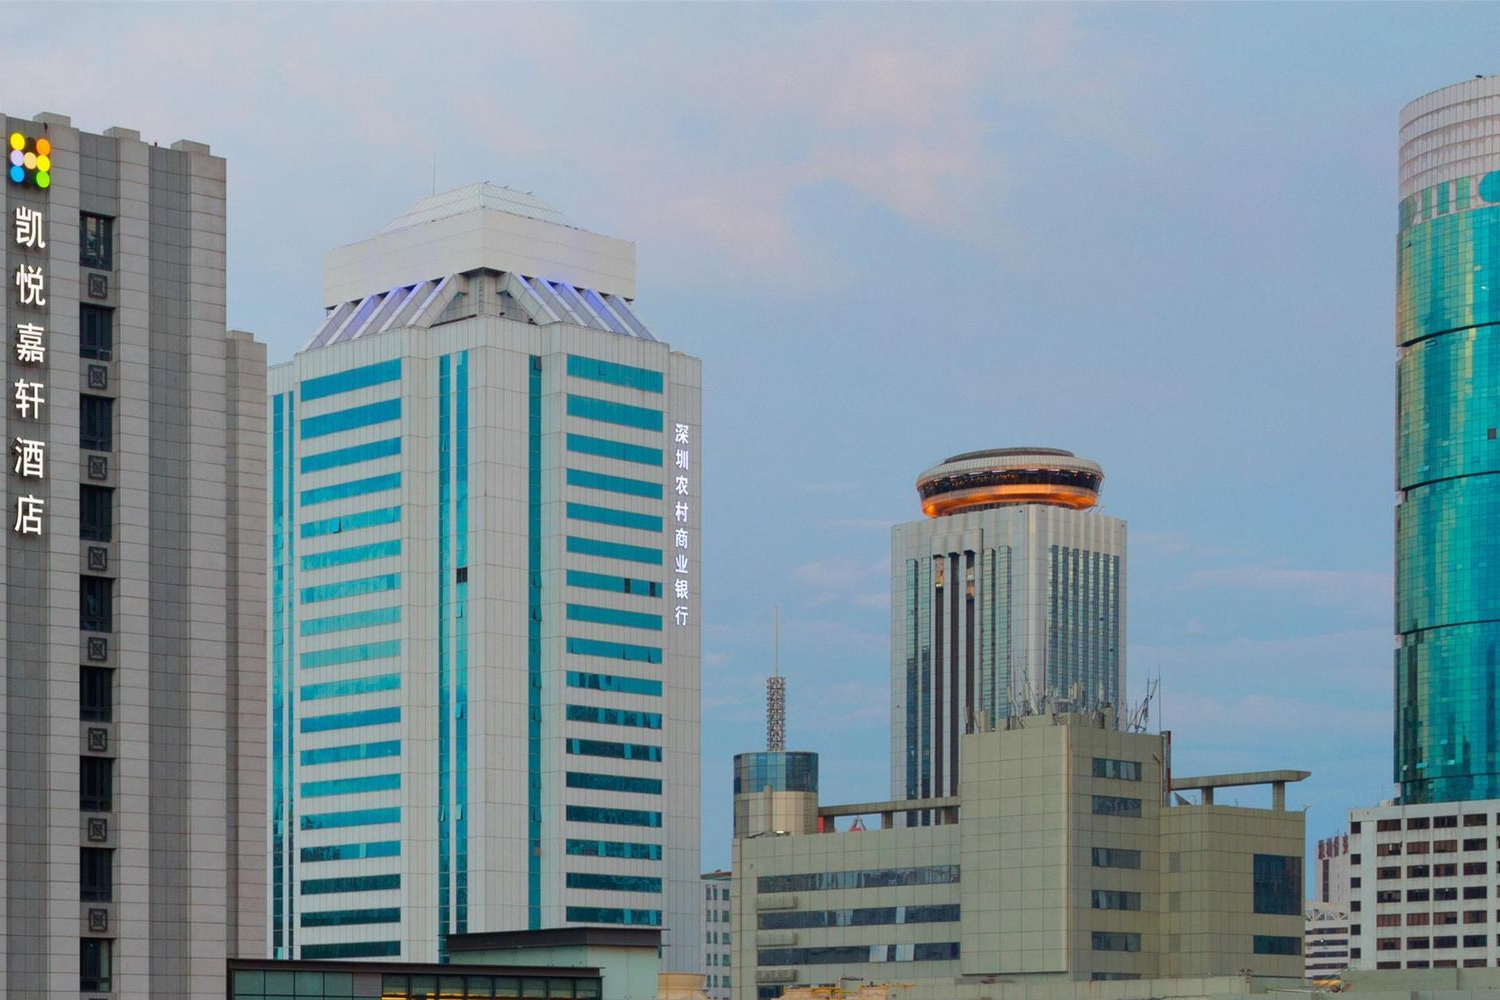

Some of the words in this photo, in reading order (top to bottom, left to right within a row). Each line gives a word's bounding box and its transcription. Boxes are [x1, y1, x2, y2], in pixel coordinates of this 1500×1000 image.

[14, 205, 46, 536] 凯悦嘉轩酒店
[674, 423, 689, 627] 深圳农村商业银行
